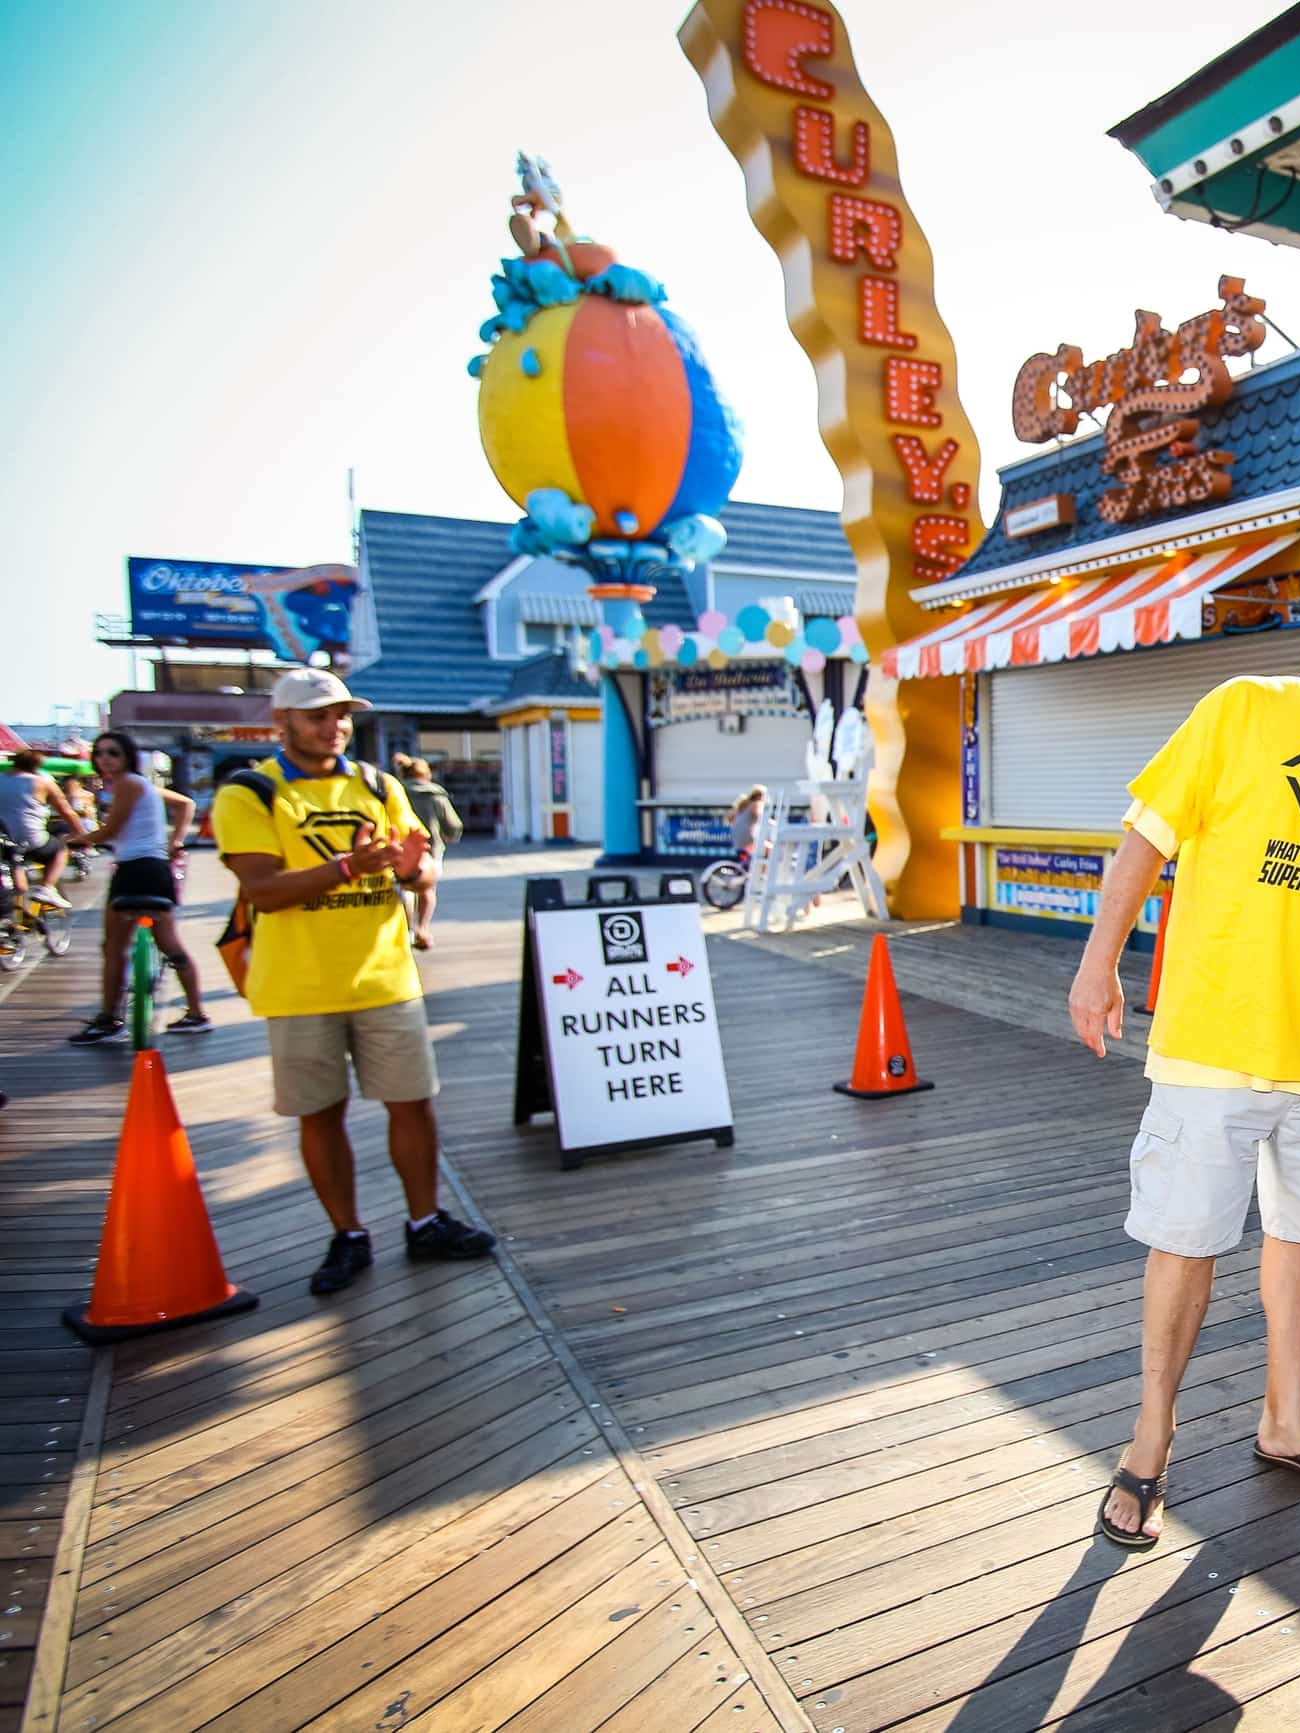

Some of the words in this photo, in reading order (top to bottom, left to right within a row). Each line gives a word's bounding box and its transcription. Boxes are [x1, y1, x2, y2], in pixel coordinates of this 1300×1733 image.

[741, 0, 970, 582] CURLEY'S
[607, 974, 657, 997] ALL
[562, 1002, 706, 1037] RUNNERS
[597, 1038, 682, 1067] TURN
[608, 1073, 683, 1102] HERE
